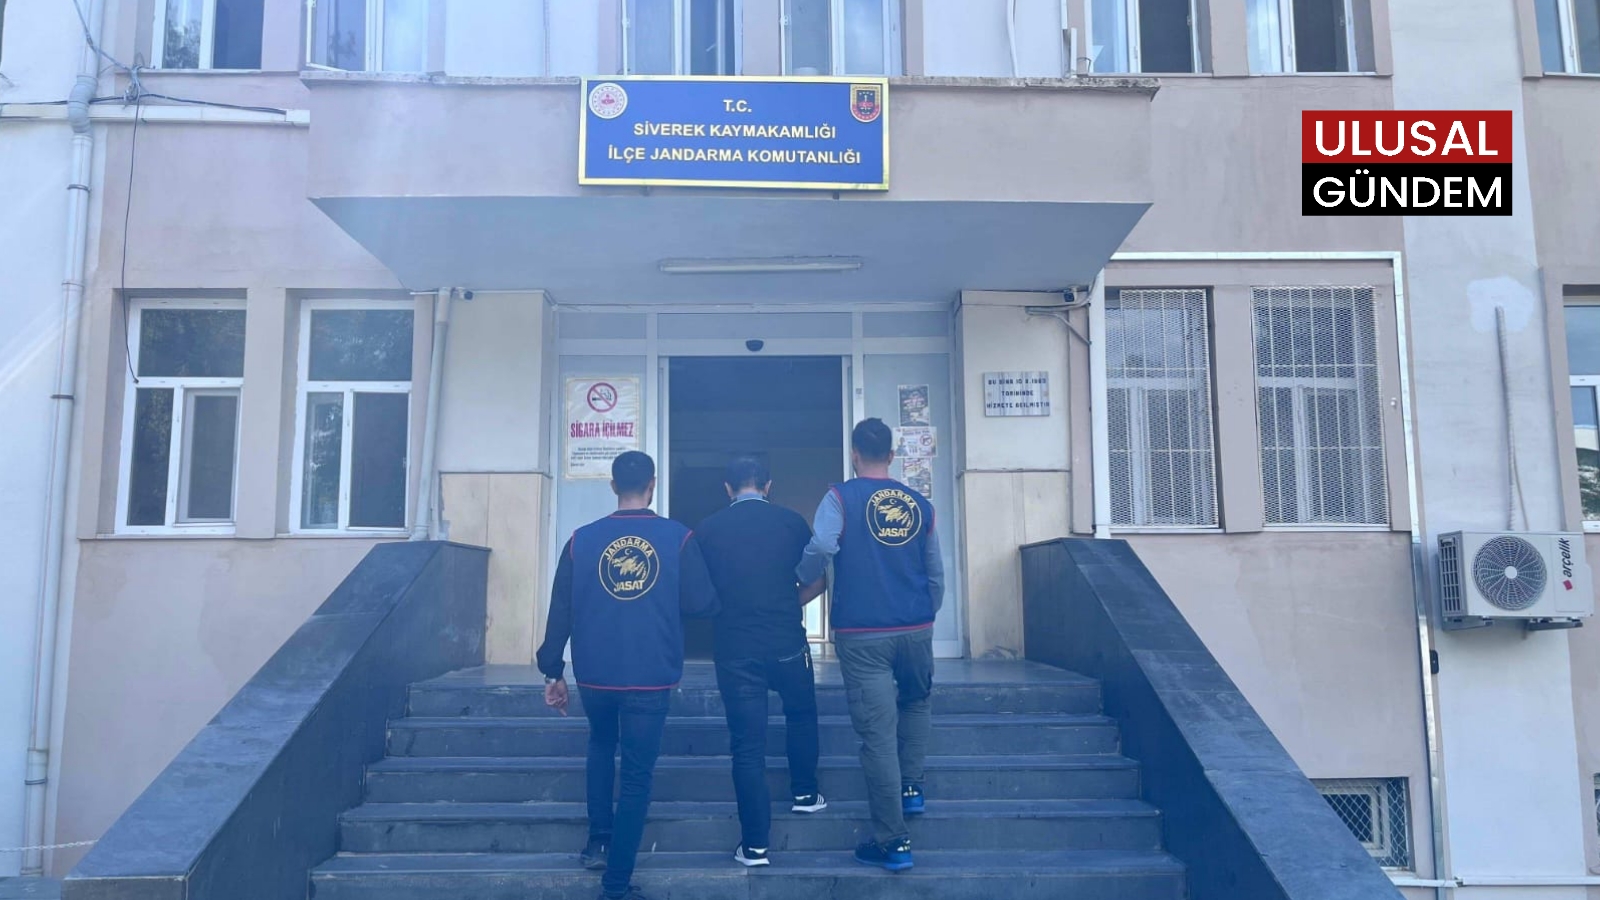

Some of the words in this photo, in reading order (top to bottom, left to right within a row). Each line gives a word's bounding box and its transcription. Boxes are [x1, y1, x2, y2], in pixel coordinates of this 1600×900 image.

[722, 99, 752, 113] T.C.
[633, 120, 706, 137] SİVEREK
[709, 122, 836, 139] KAYMAKAMLIĞI
[608, 144, 646, 163] İLÇE
[650, 147, 744, 162] JANDARMA
[747, 148, 861, 164] KOMUTANLIĞI
[570, 420, 600, 438] SİGARA
[602, 419, 634, 439] İÇİLMEZ
[871, 490, 916, 508] JANDARMA
[878, 527, 909, 537] JASAT
[604, 537, 654, 561] JANDARMA
[1558, 538, 1574, 578] arçelik
[613, 580, 645, 593] JASAT
